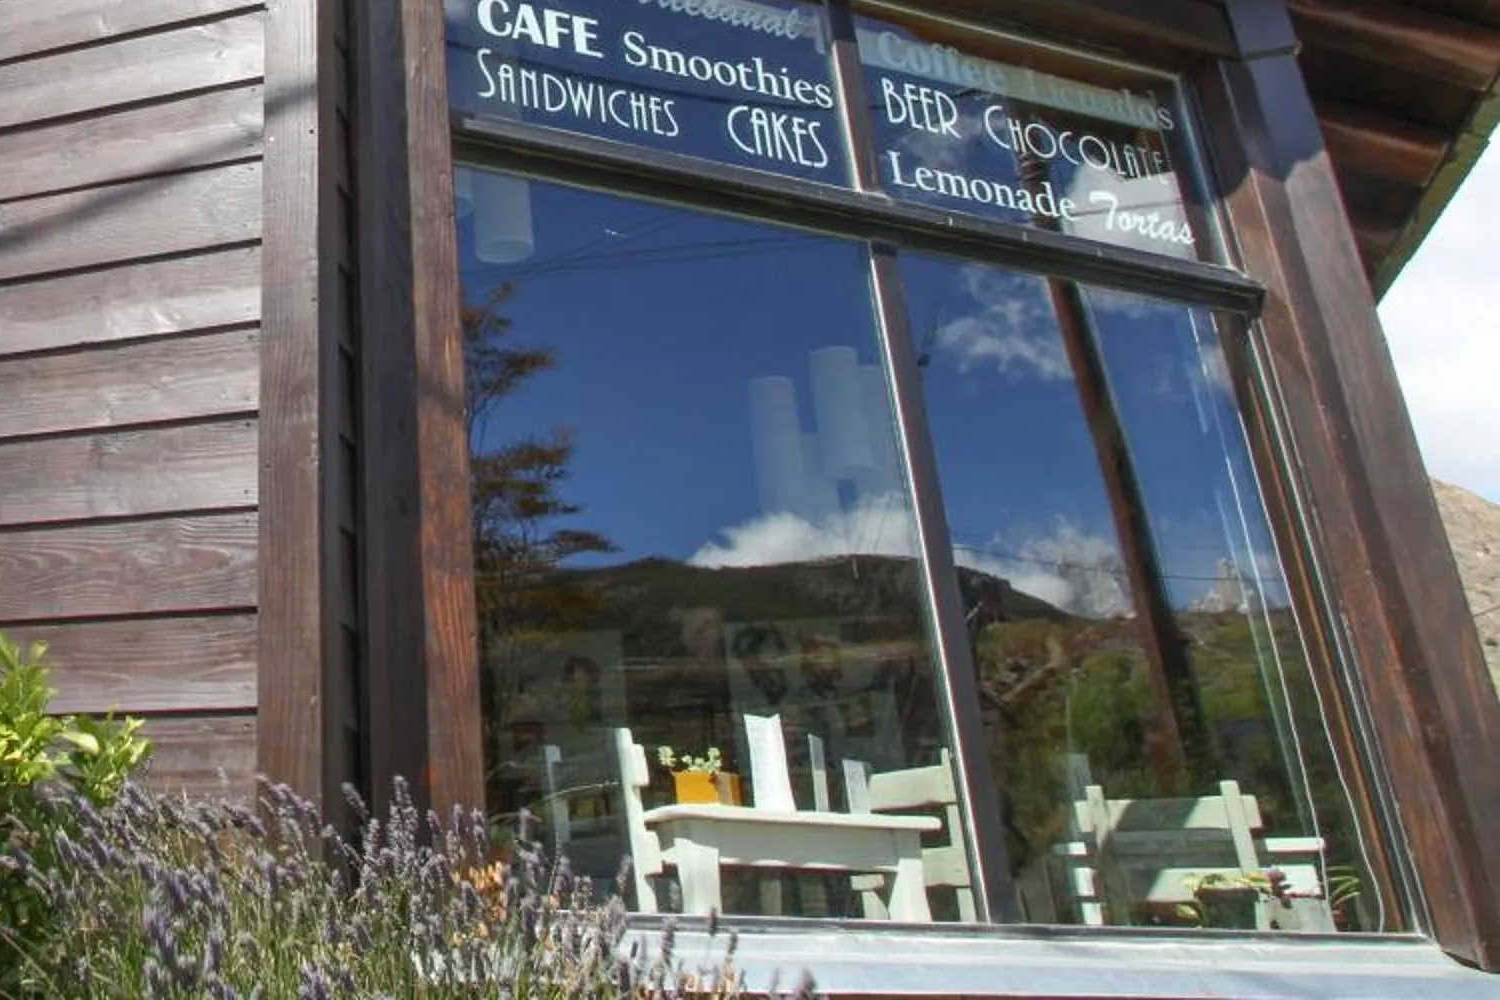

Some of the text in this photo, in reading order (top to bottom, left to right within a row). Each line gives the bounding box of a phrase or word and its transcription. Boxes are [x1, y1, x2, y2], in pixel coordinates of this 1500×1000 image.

[623, 31, 833, 109] Smoothies
[878, 31, 1007, 92] Coffee
[727, 105, 829, 169] CAKES
[881, 77, 961, 139] BEER
[887, 150, 1195, 246] Lemonade Tortas
